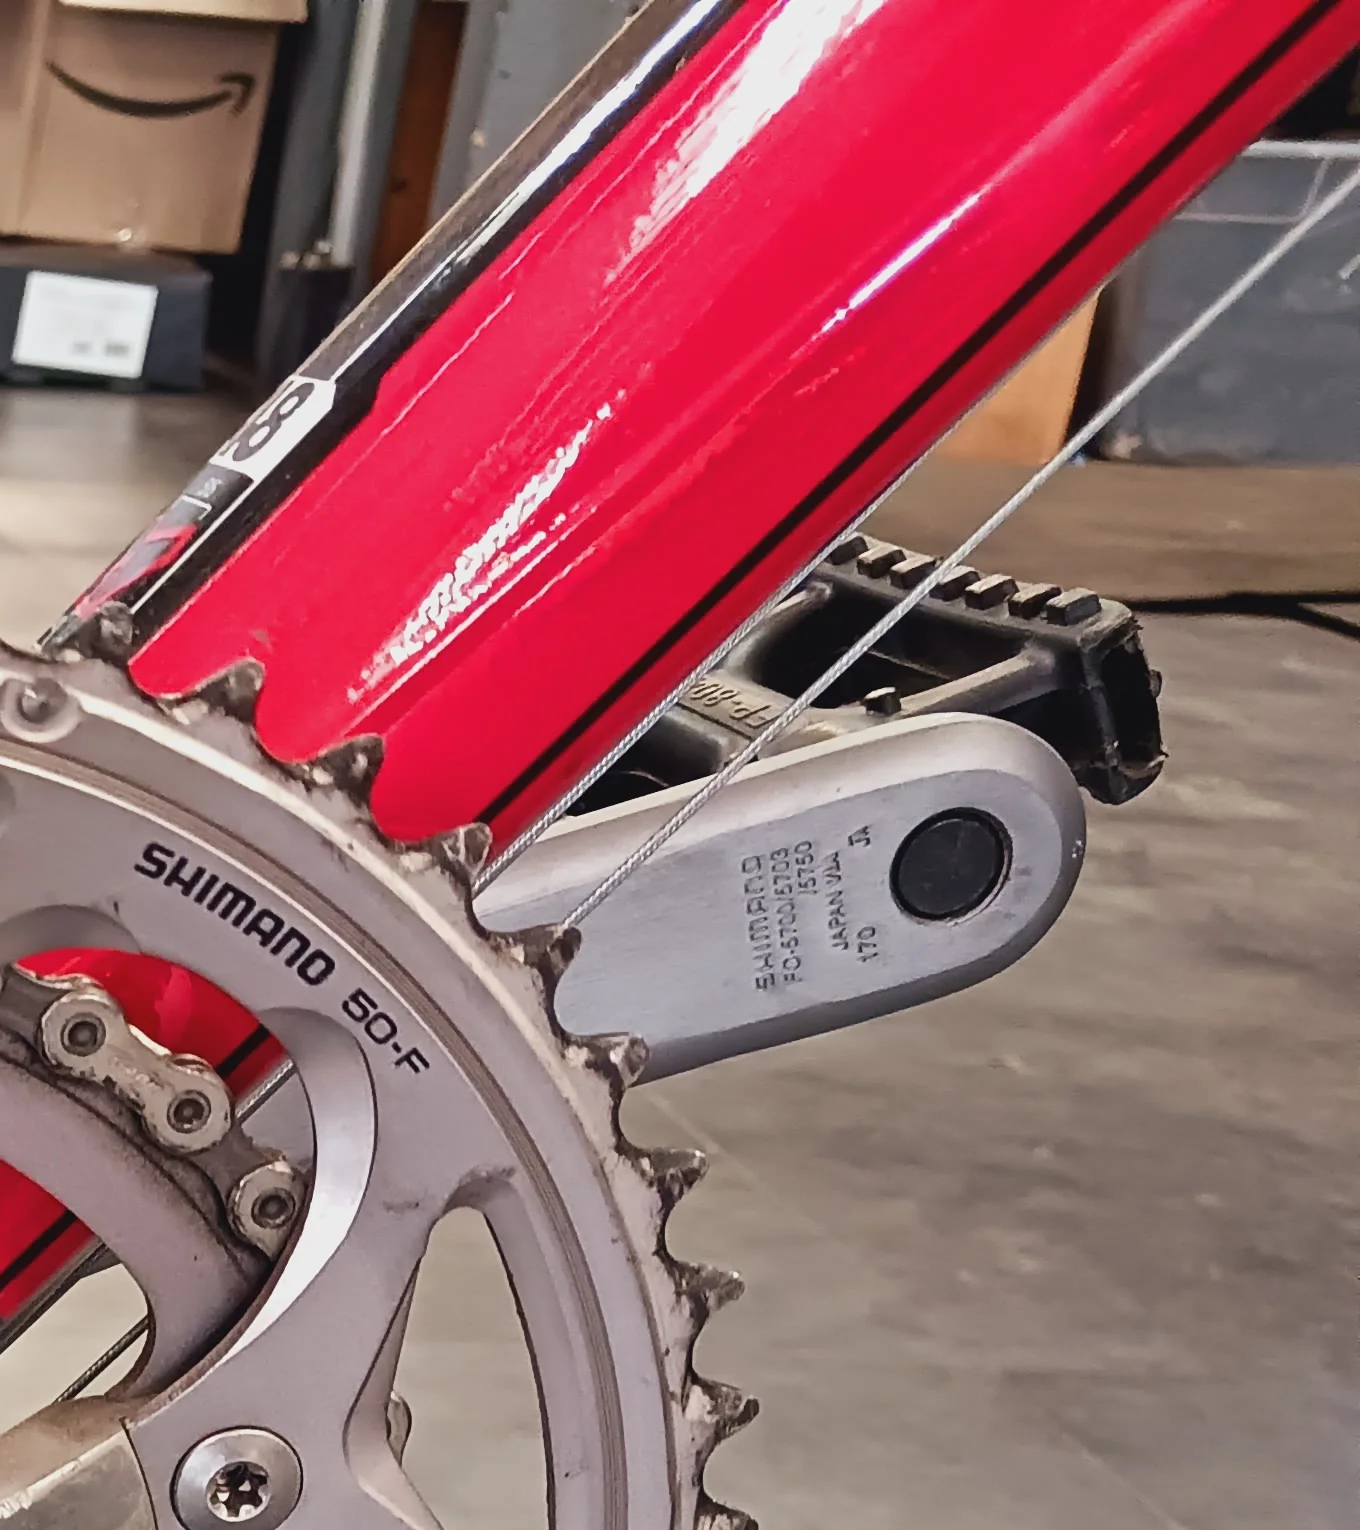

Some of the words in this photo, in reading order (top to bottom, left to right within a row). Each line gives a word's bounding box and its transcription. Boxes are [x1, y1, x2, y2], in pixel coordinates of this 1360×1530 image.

[133, 841, 336, 986] SHIMANO
[341, 987, 431, 1075] 50-F
[741, 855, 776, 991] SHIMANO
[825, 889, 849, 950] JAPAN
[856, 925, 878, 963] 170
